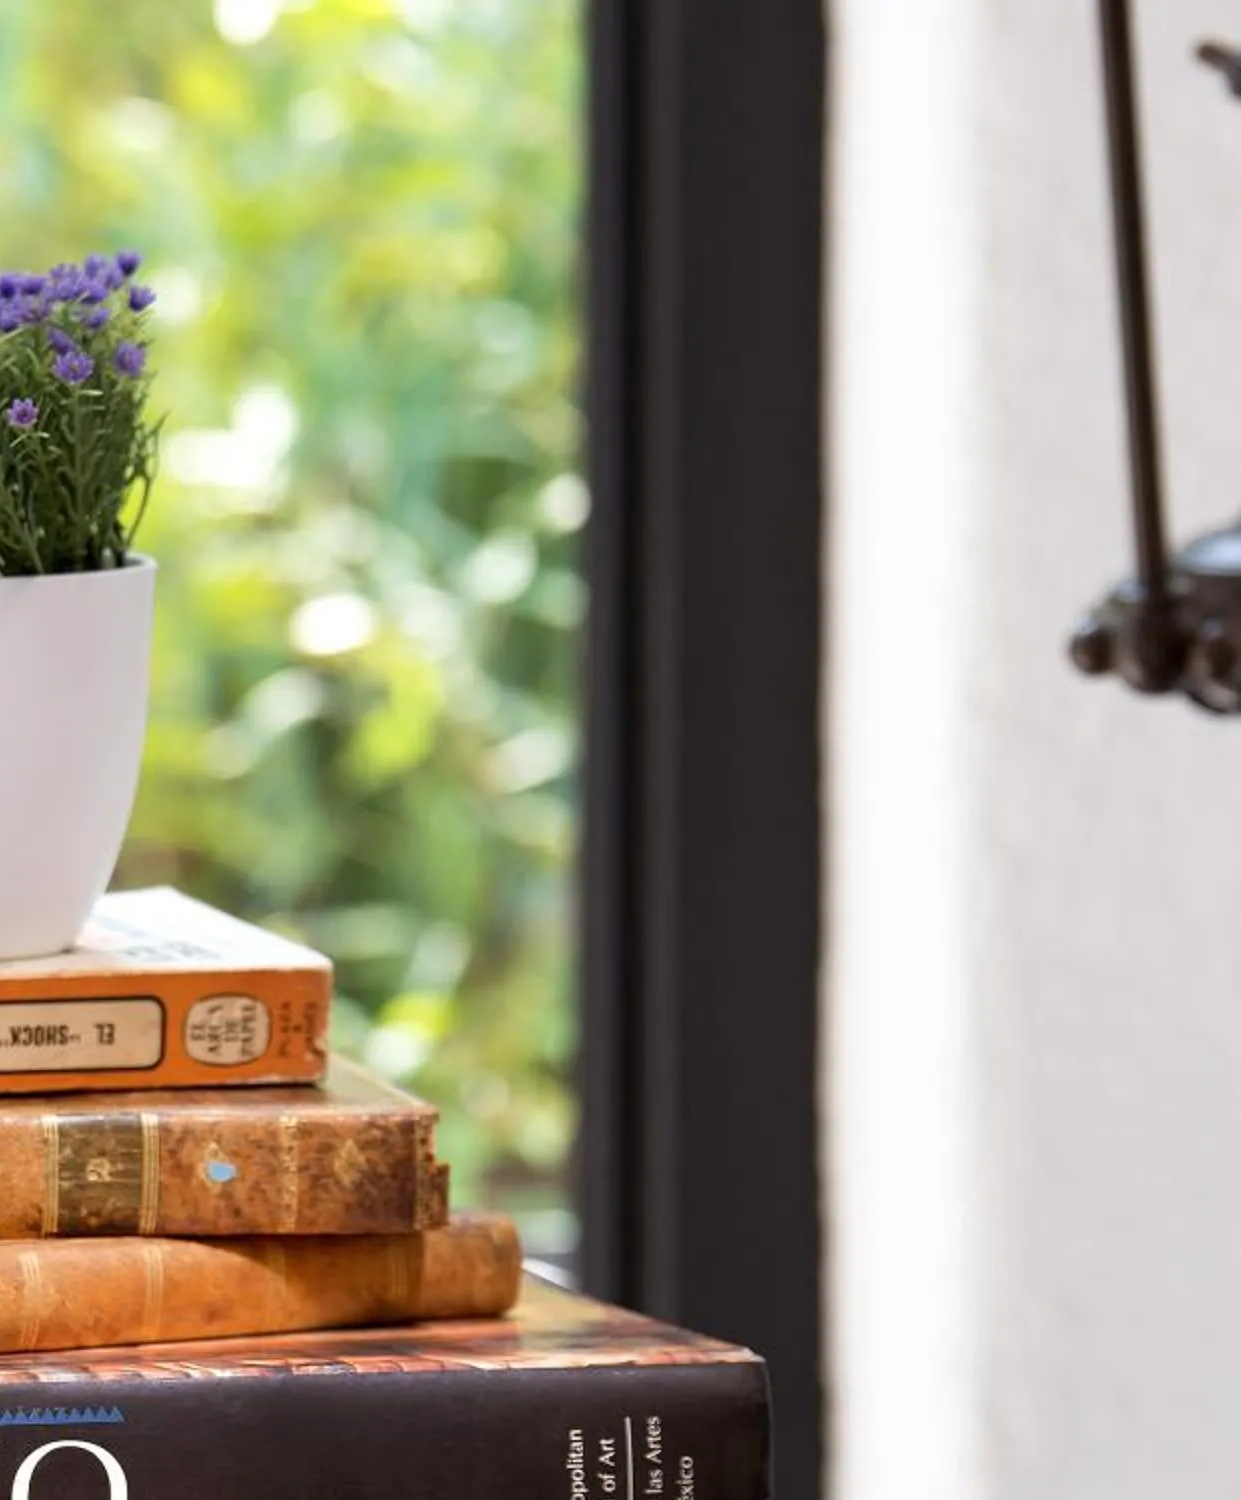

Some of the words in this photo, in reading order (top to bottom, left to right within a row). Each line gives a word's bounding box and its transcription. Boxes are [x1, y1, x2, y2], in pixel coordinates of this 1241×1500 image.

[94, 1023, 117, 1046] EL
[599, 1437, 616, 1467] Art
[644, 1415, 663, 1465] Artes
[598, 1471, 616, 1493] of
[644, 1468, 664, 1494] las
